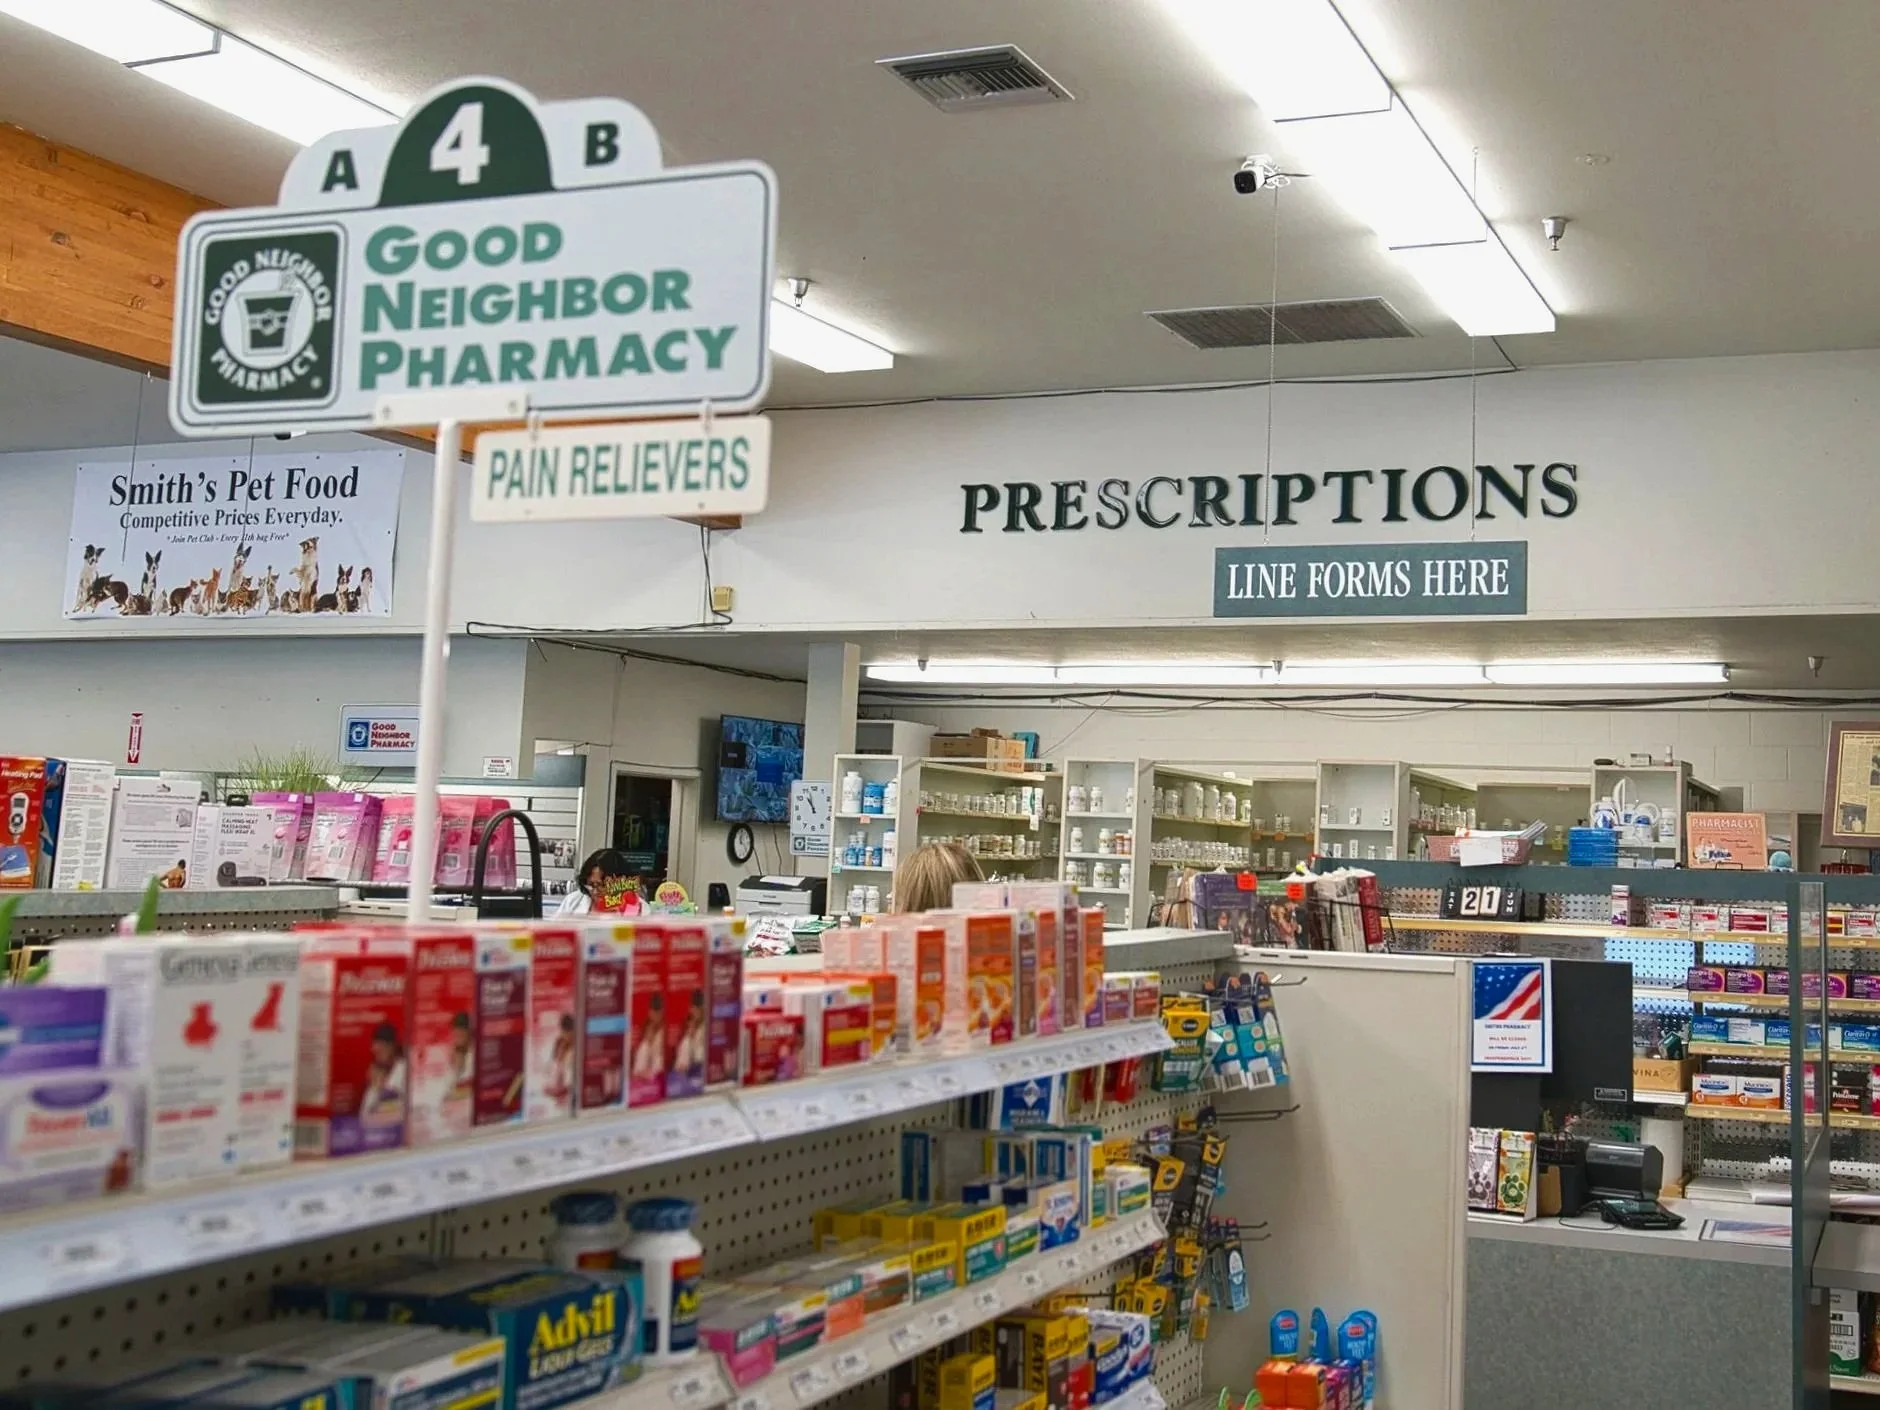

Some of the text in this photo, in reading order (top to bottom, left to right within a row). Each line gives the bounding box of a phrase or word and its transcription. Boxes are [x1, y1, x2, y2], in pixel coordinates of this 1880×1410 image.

[429, 102, 490, 185] 4
[585, 122, 619, 167] B
[321, 149, 359, 192] A
[365, 222, 563, 275] GOOD
[205, 259, 250, 325] GOOD
[361, 269, 692, 333] NEIGHBOR
[210, 343, 319, 393] PHARMACY
[359, 325, 739, 391] PHARMACY
[109, 465, 360, 507] Smith's Pet Food
[488, 437, 751, 500] PAIN RELIEVERS
[119, 505, 344, 533] Competitive Prices Everyday.
[959, 462, 1579, 534] PRESCRIPTIONS
[1226, 558, 1510, 600] LINE FORMS HERE
[370, 739, 416, 748] PHARMACY
[371, 722, 396, 731] GOOD
[1692, 817, 1760, 829] PHARMACIST
[532, 1292, 617, 1350] Advil
